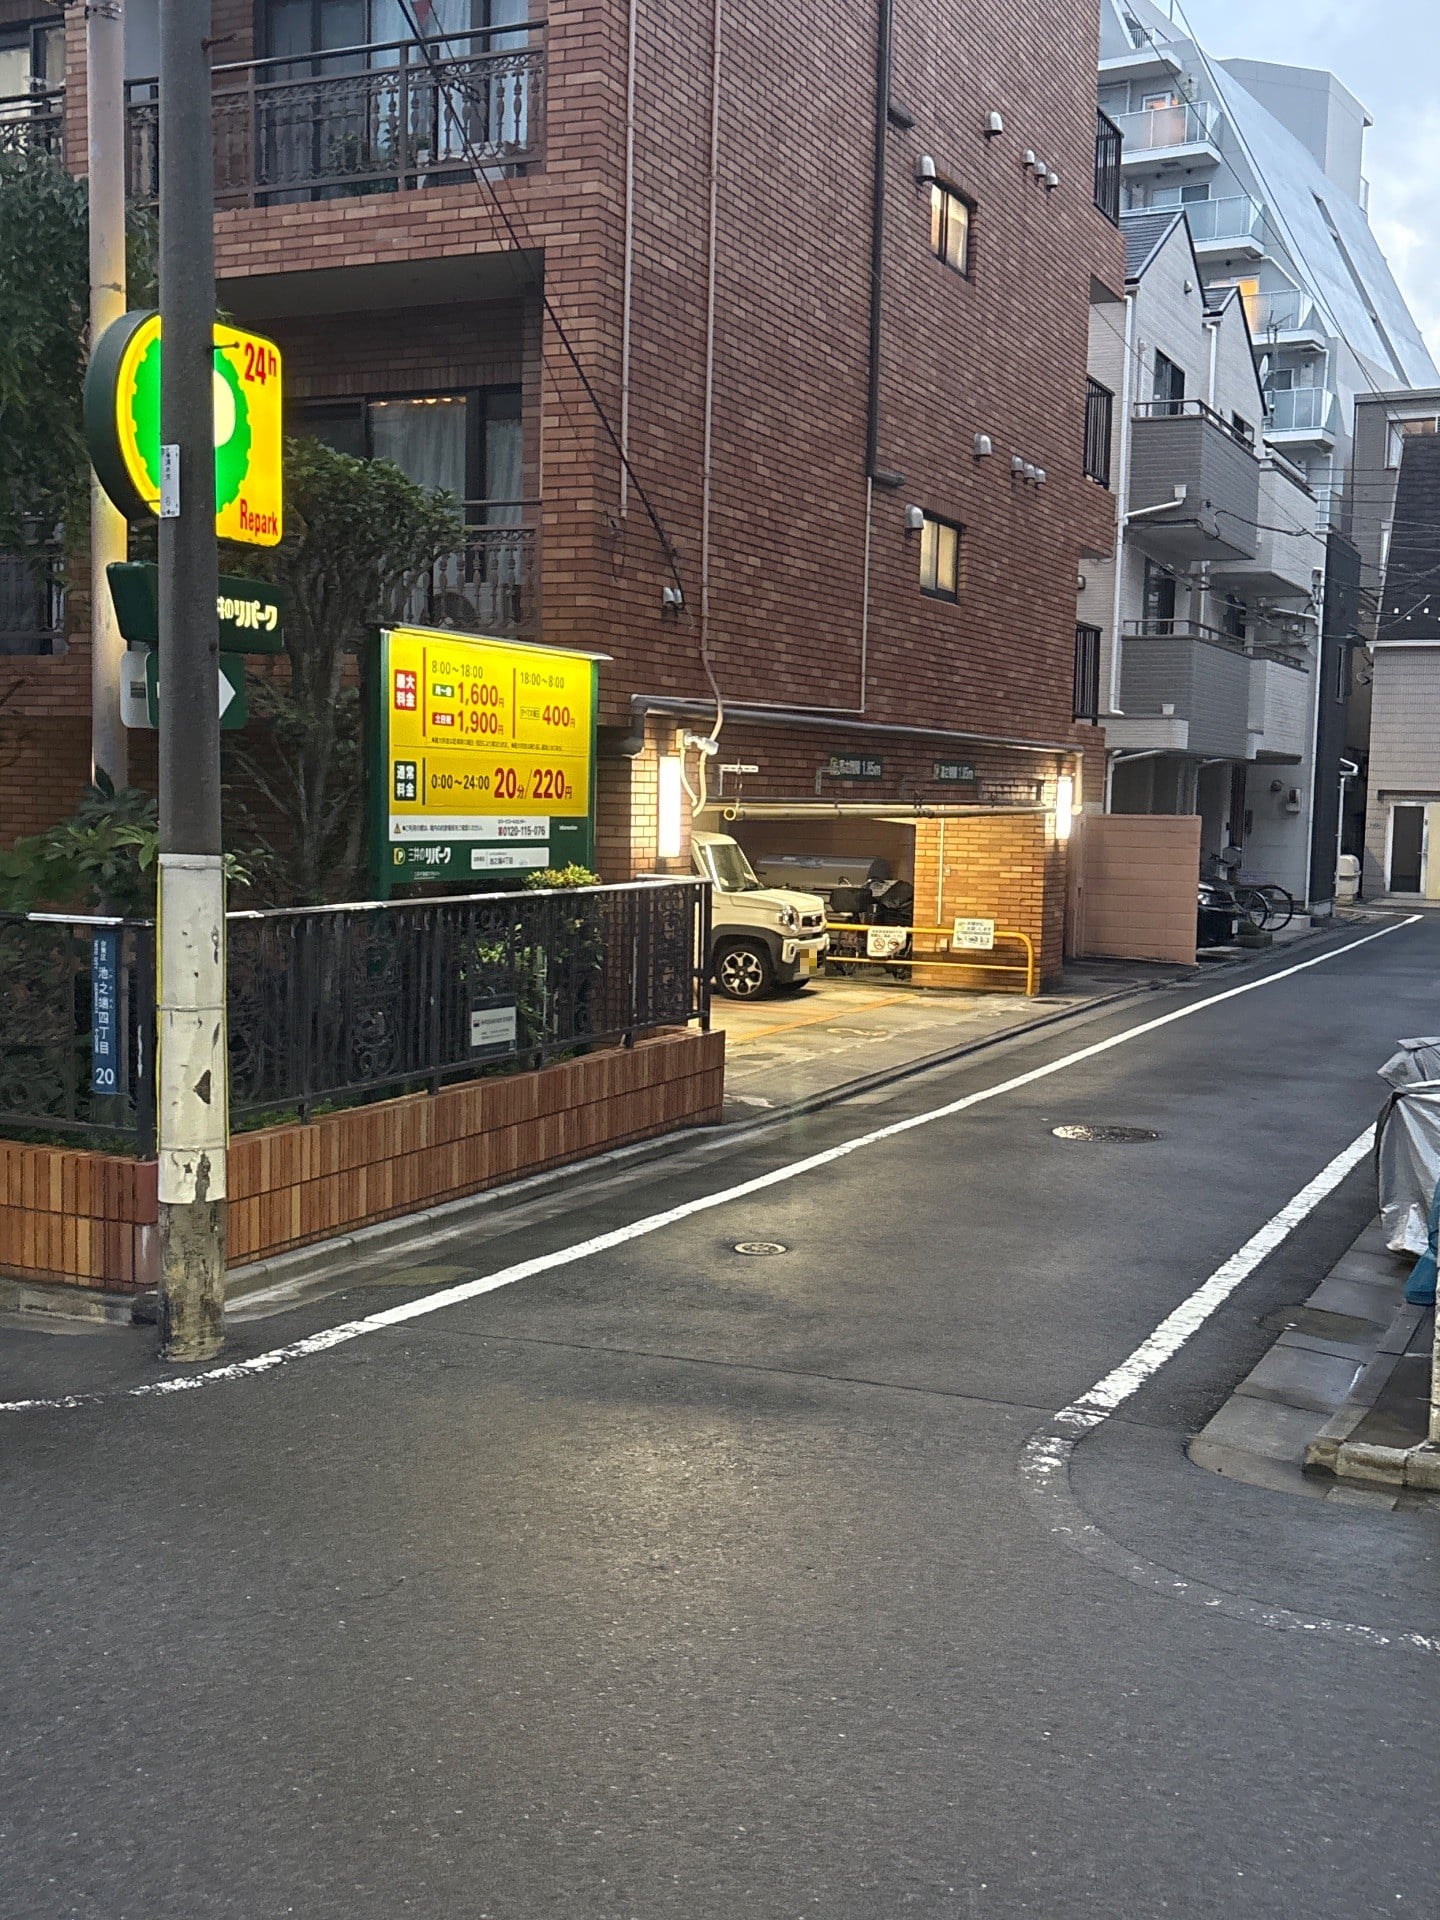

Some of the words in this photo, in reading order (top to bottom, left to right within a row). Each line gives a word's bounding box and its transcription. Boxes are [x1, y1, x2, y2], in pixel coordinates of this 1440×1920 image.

[244, 341, 278, 386] 24h
[240, 498, 279, 538] Repark
[396, 691, 416, 708] 料金
[396, 765, 415, 780] 通常
[396, 782, 415, 798] 料金
[408, 845, 452, 865] 三井のリパーク
[99, 966, 109, 1055] 池之端四丁目
[95, 1067, 114, 1085] 20
